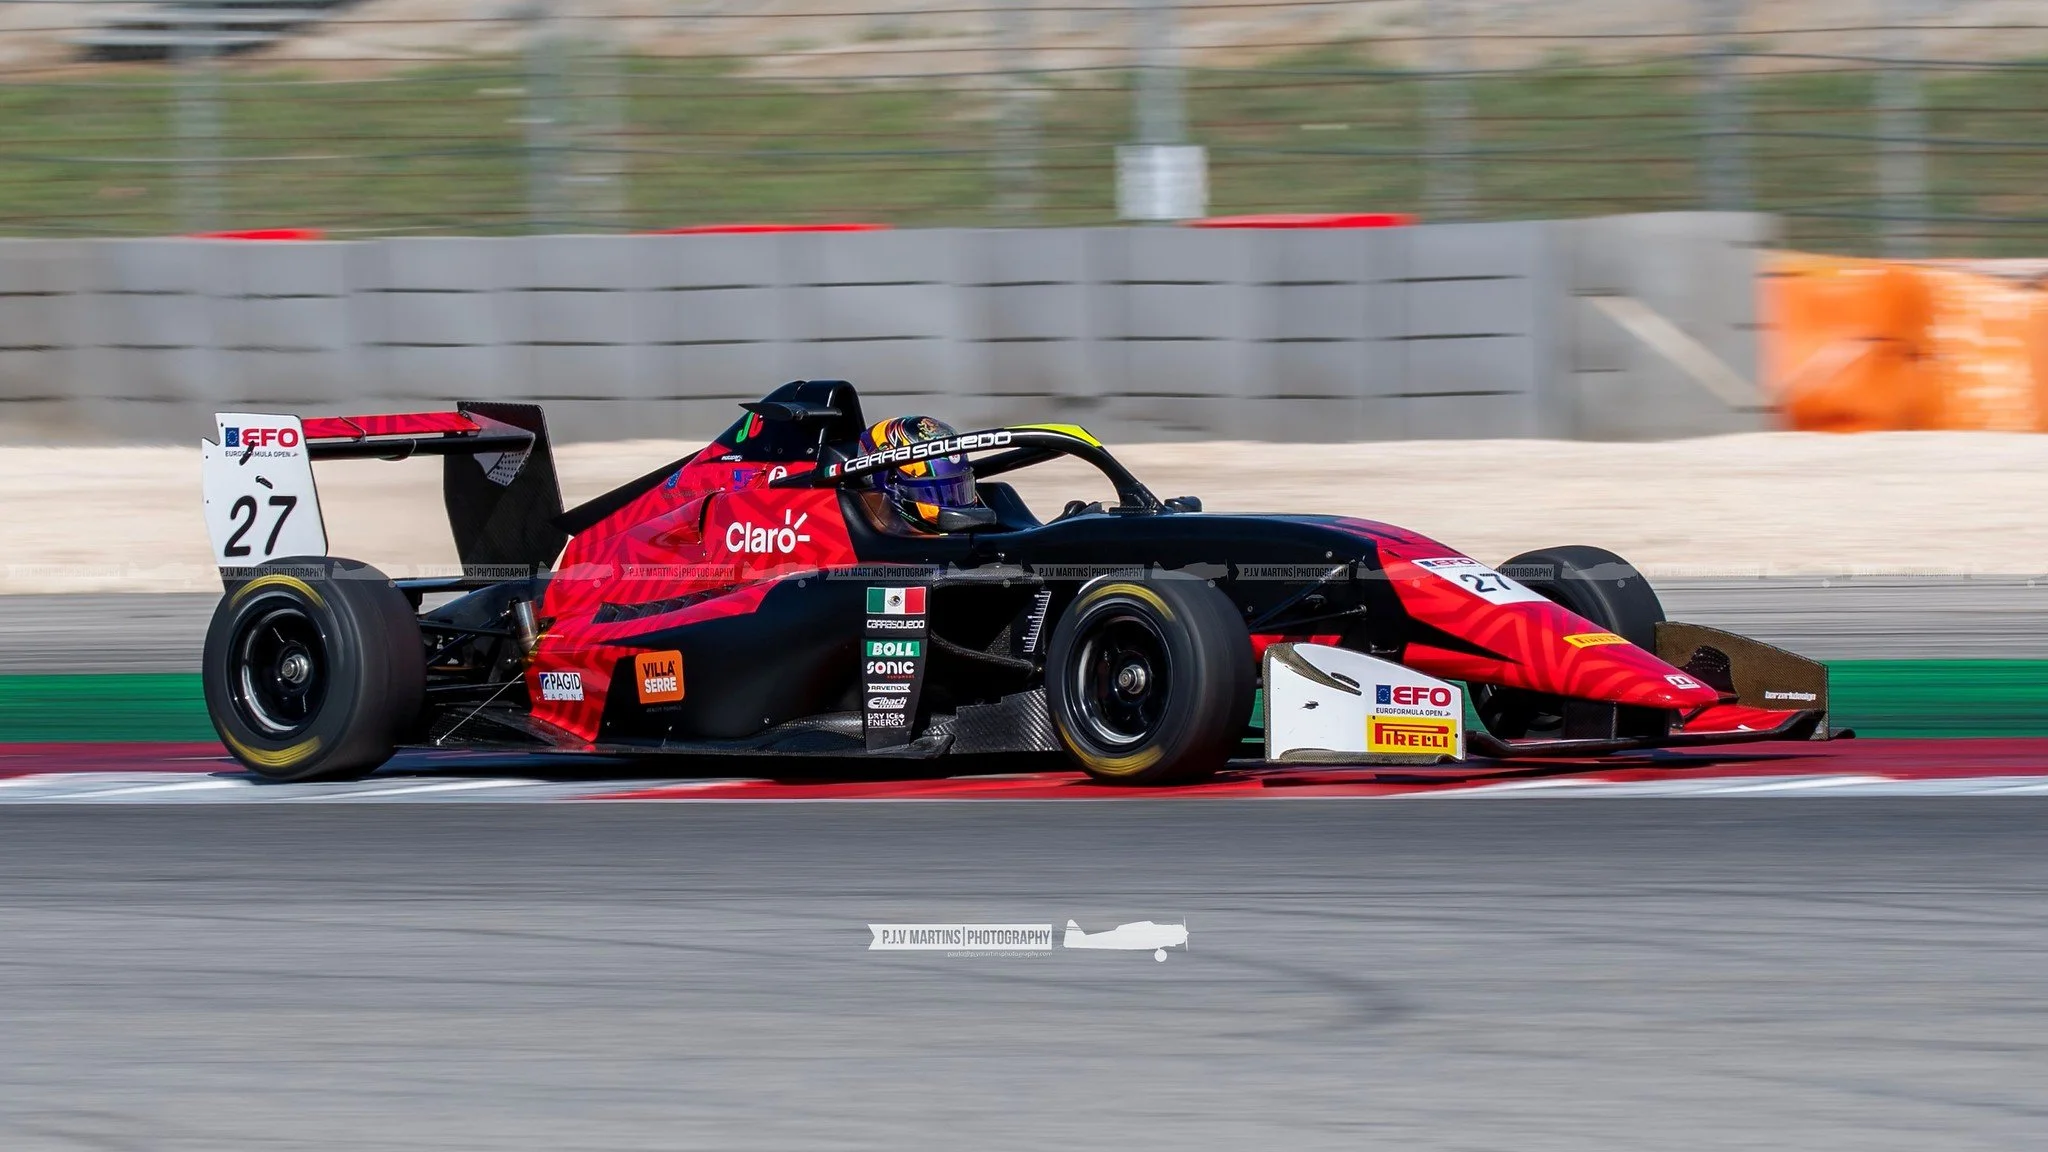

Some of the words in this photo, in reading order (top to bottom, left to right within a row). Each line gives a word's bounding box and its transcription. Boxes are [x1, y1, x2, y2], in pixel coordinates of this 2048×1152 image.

[242, 428, 299, 448] EFO
[273, 450, 291, 458] OPEN
[224, 494, 297, 557] 27
[726, 521, 796, 553] Claro
[1460, 573, 1511, 592] 27
[872, 642, 914, 656] BOLL
[550, 673, 581, 690] PAGID
[644, 676, 677, 693] SERRE
[1393, 686, 1451, 707] EFO
[1376, 707, 1424, 716] EUROFORMULA
[1425, 709, 1443, 717] OPEN
[867, 718, 905, 727] ENERGY
[1375, 722, 1449, 748] PIRELLI
